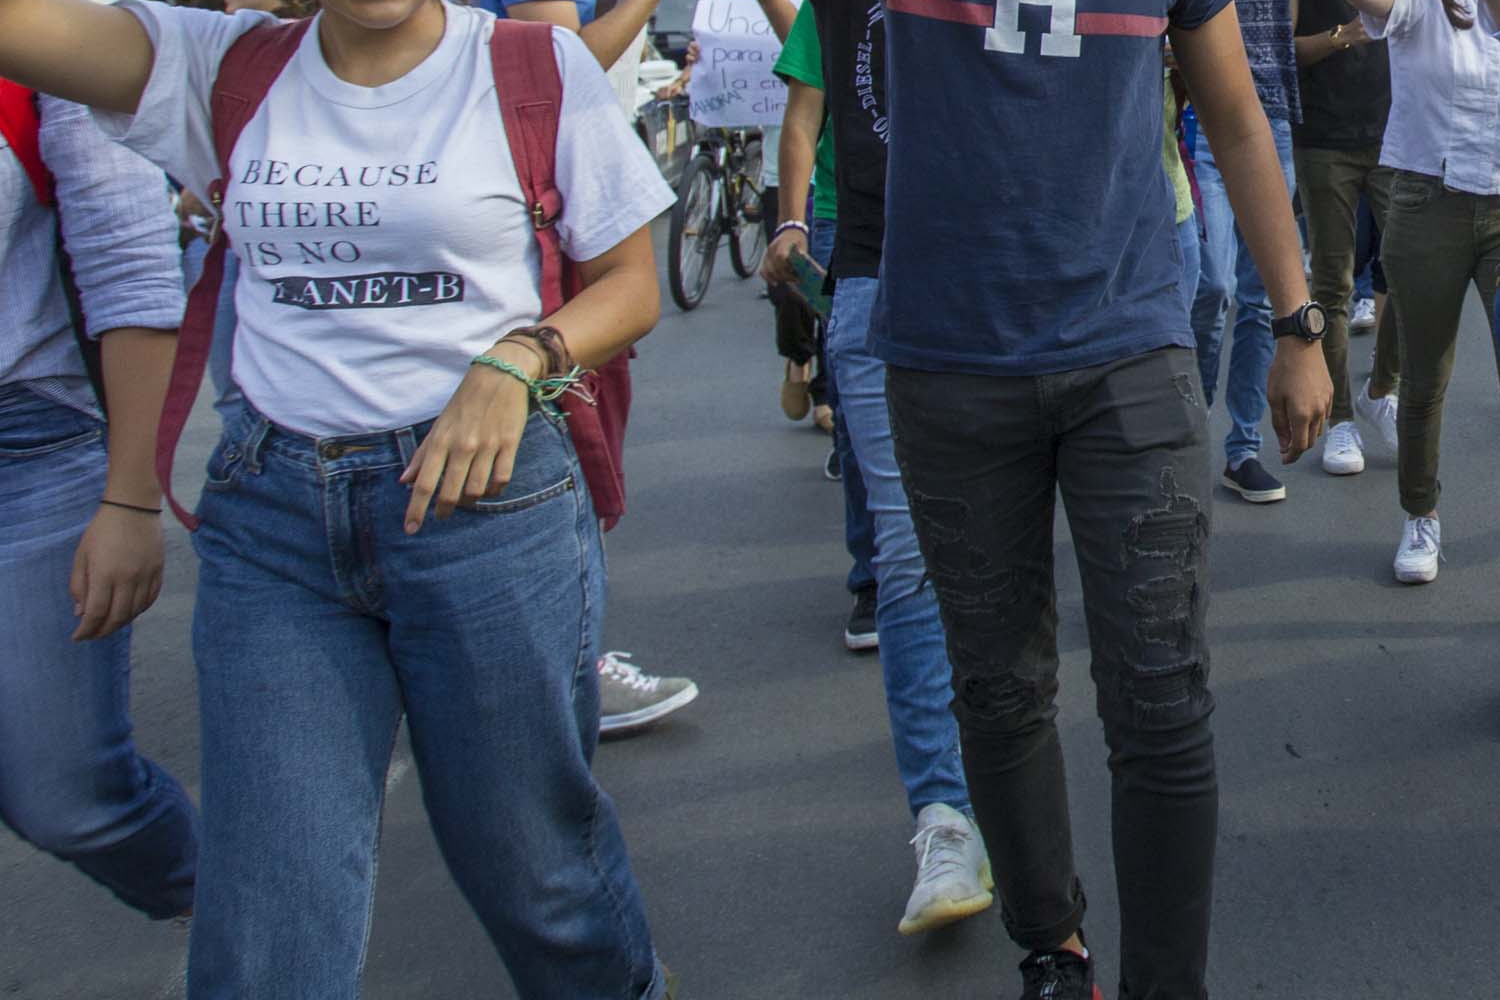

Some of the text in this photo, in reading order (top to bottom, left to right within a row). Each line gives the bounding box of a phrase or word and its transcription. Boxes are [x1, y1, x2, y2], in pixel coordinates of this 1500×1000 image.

[240, 160, 439, 188] BECAUSE
[235, 201, 381, 228] THERE
[243, 240, 361, 267] IS NO
[276, 274, 461, 305] ANET-B
